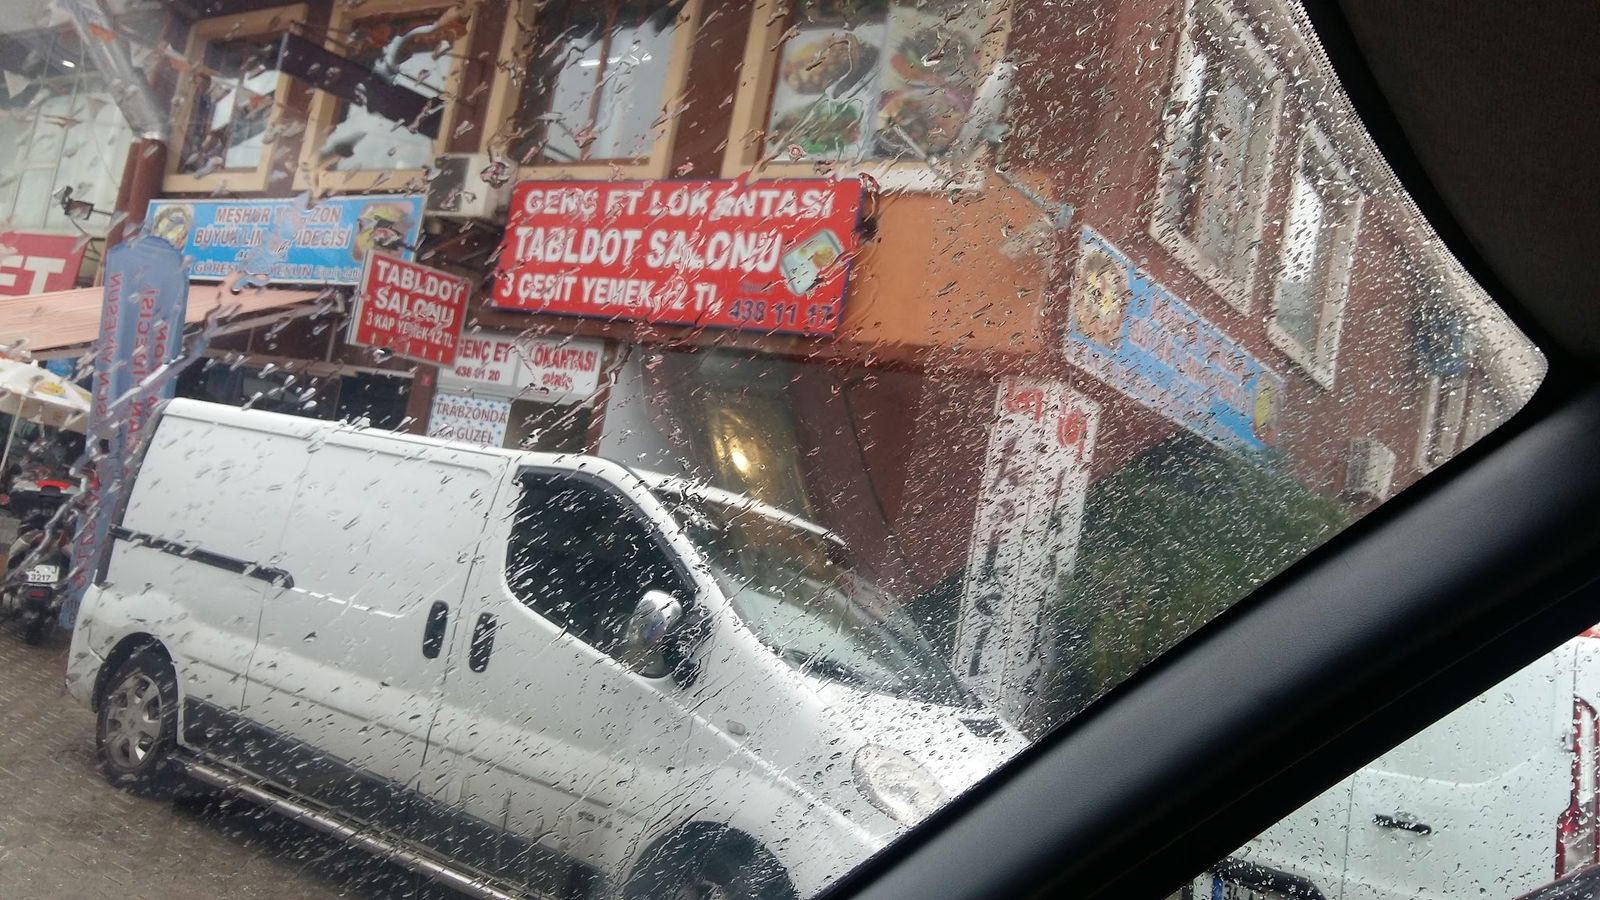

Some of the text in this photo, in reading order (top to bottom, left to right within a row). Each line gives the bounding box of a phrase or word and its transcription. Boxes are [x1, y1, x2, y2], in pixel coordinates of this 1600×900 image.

[515, 226, 783, 272] TABLDOT SALONU
[378, 260, 464, 304] TABLDOT
[501, 272, 514, 297] 3
[582, 276, 655, 308] YEMEK
[366, 310, 373, 326] 3
[374, 314, 395, 332] KAP
[730, 298, 765, 322] 438
[775, 302, 797, 325] 11
[494, 341, 512, 363] ET
[529, 345, 598, 372] OKANTASI
[455, 366, 473, 377] 438
[488, 370, 501, 381] 20
[436, 402, 508, 424] TRABZONDA
